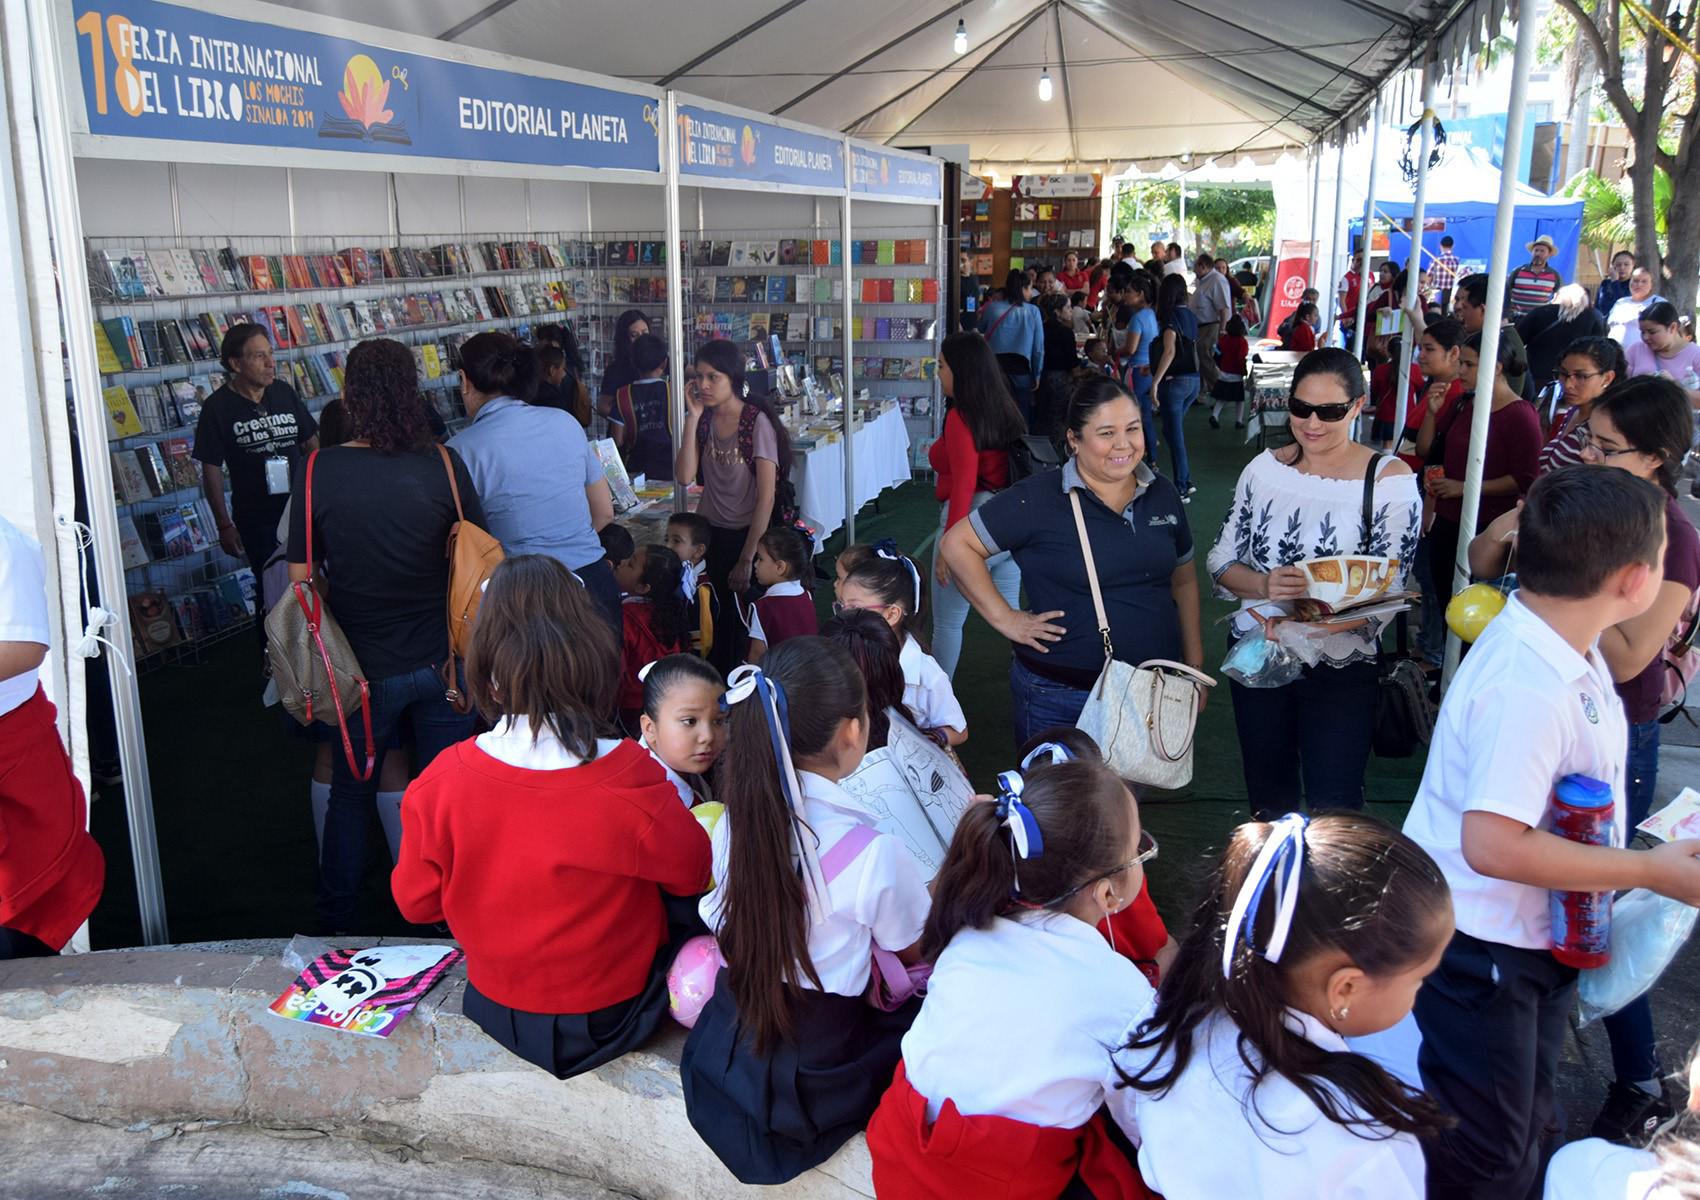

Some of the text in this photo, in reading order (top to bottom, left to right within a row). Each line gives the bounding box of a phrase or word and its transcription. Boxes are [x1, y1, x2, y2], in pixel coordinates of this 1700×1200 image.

[76, 11, 144, 117] 18
[119, 24, 323, 87] FERIA INTERNACIONAL
[125, 68, 243, 122] DEL LIBRO
[243, 79, 304, 107] LOS MOCHIS
[245, 103, 315, 130] SINALOA 2019
[459, 96, 628, 144] EDITORIAL PLANETA
[775, 145, 807, 169] EDITORIAL
[808, 151, 833, 171] PLANETA
[252, 431, 270, 442] los
[285, 992, 394, 1033] Colorea
